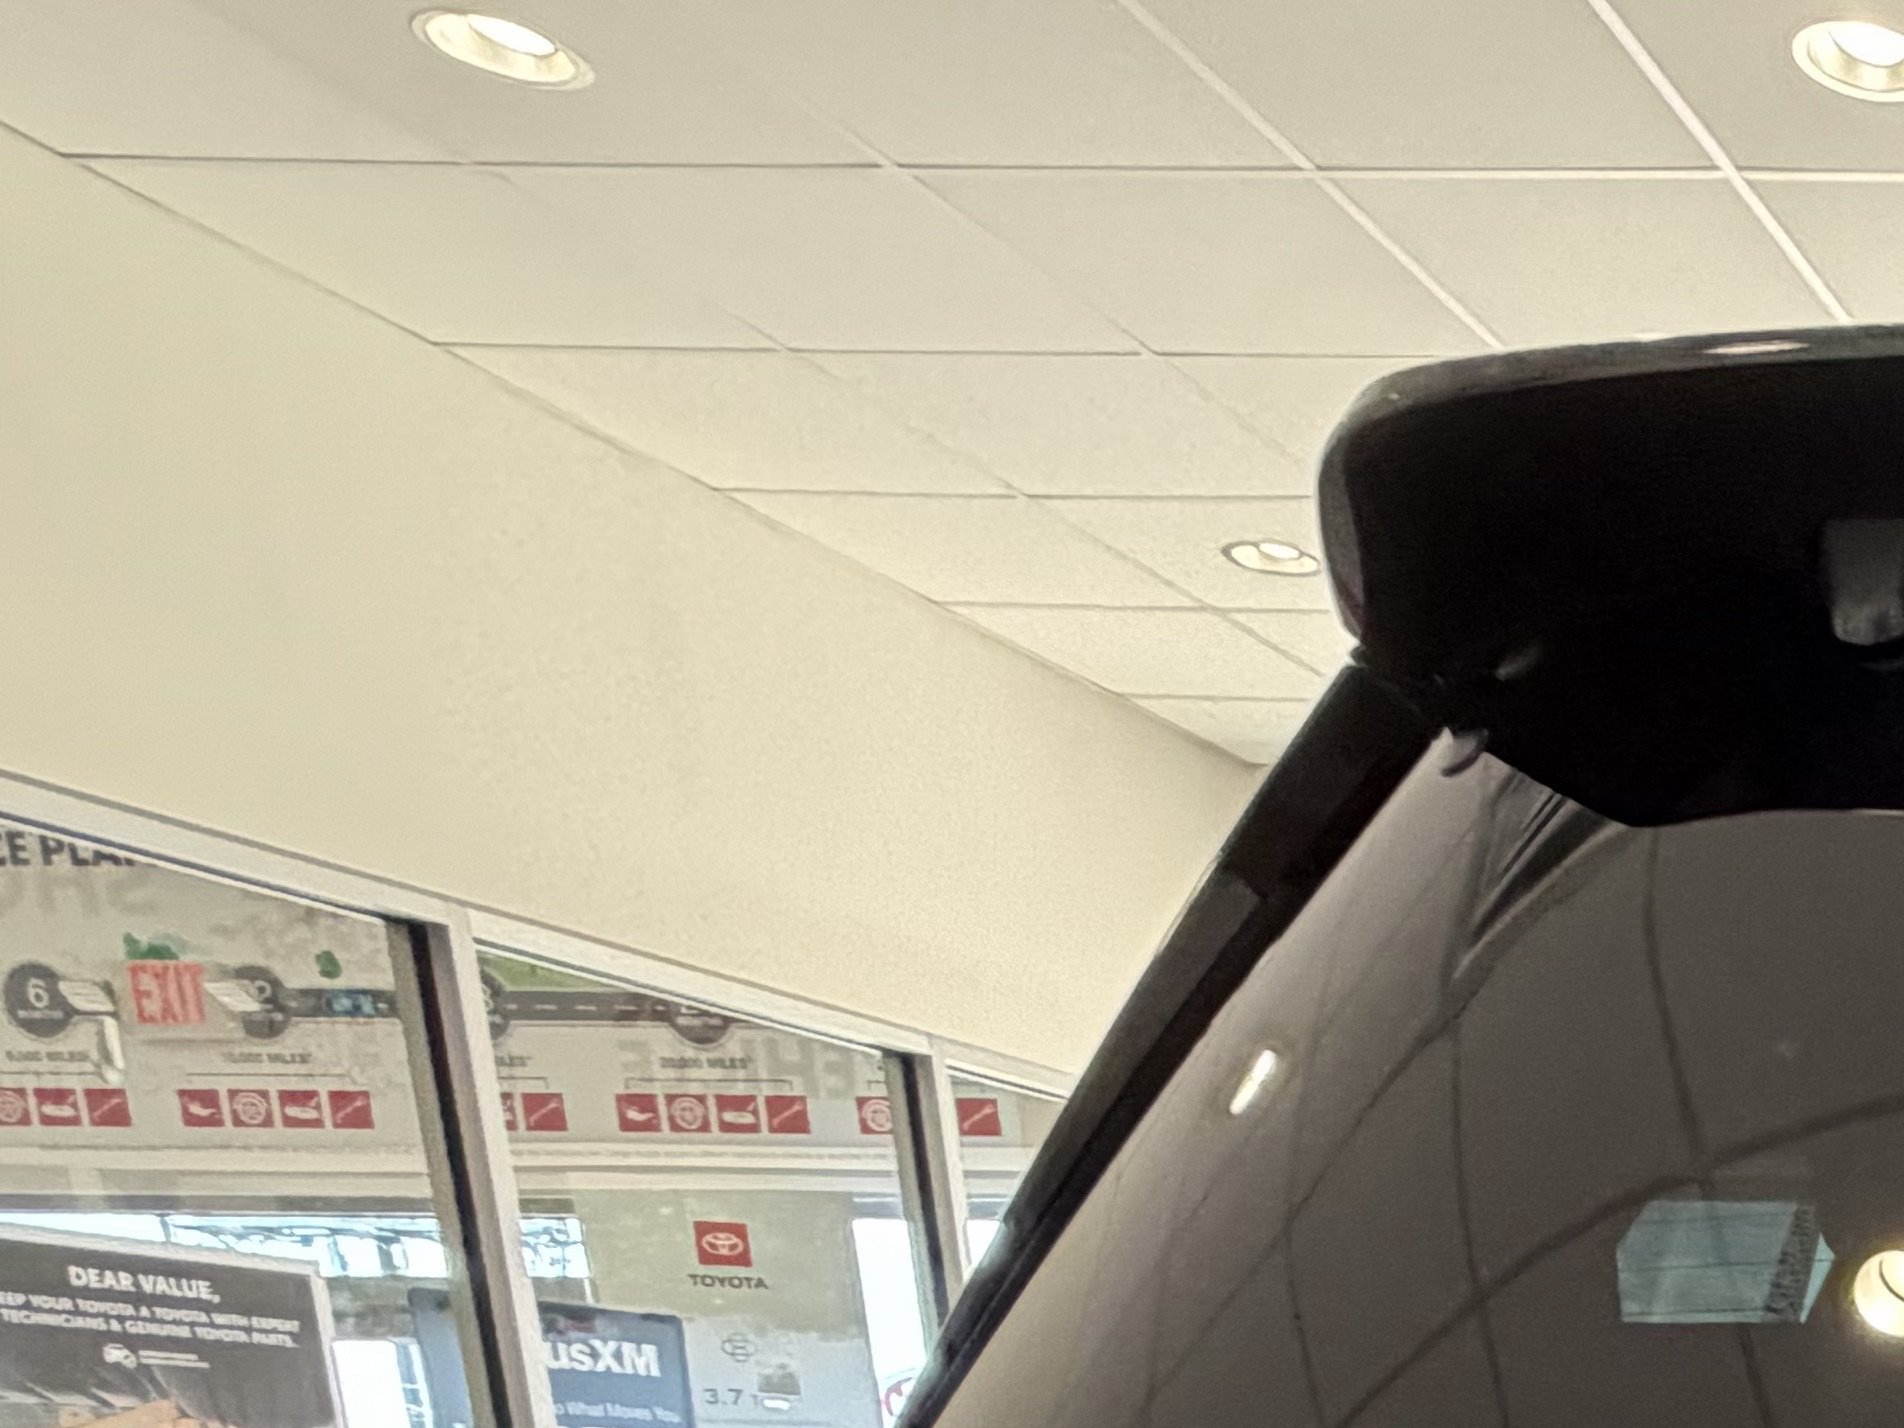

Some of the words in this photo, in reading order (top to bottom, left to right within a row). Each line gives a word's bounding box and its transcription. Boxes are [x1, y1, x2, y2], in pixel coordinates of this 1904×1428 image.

[28, 977, 49, 1008] 6
[68, 1265, 137, 1292] DEAR
[687, 1273, 769, 1290] TOYOTA
